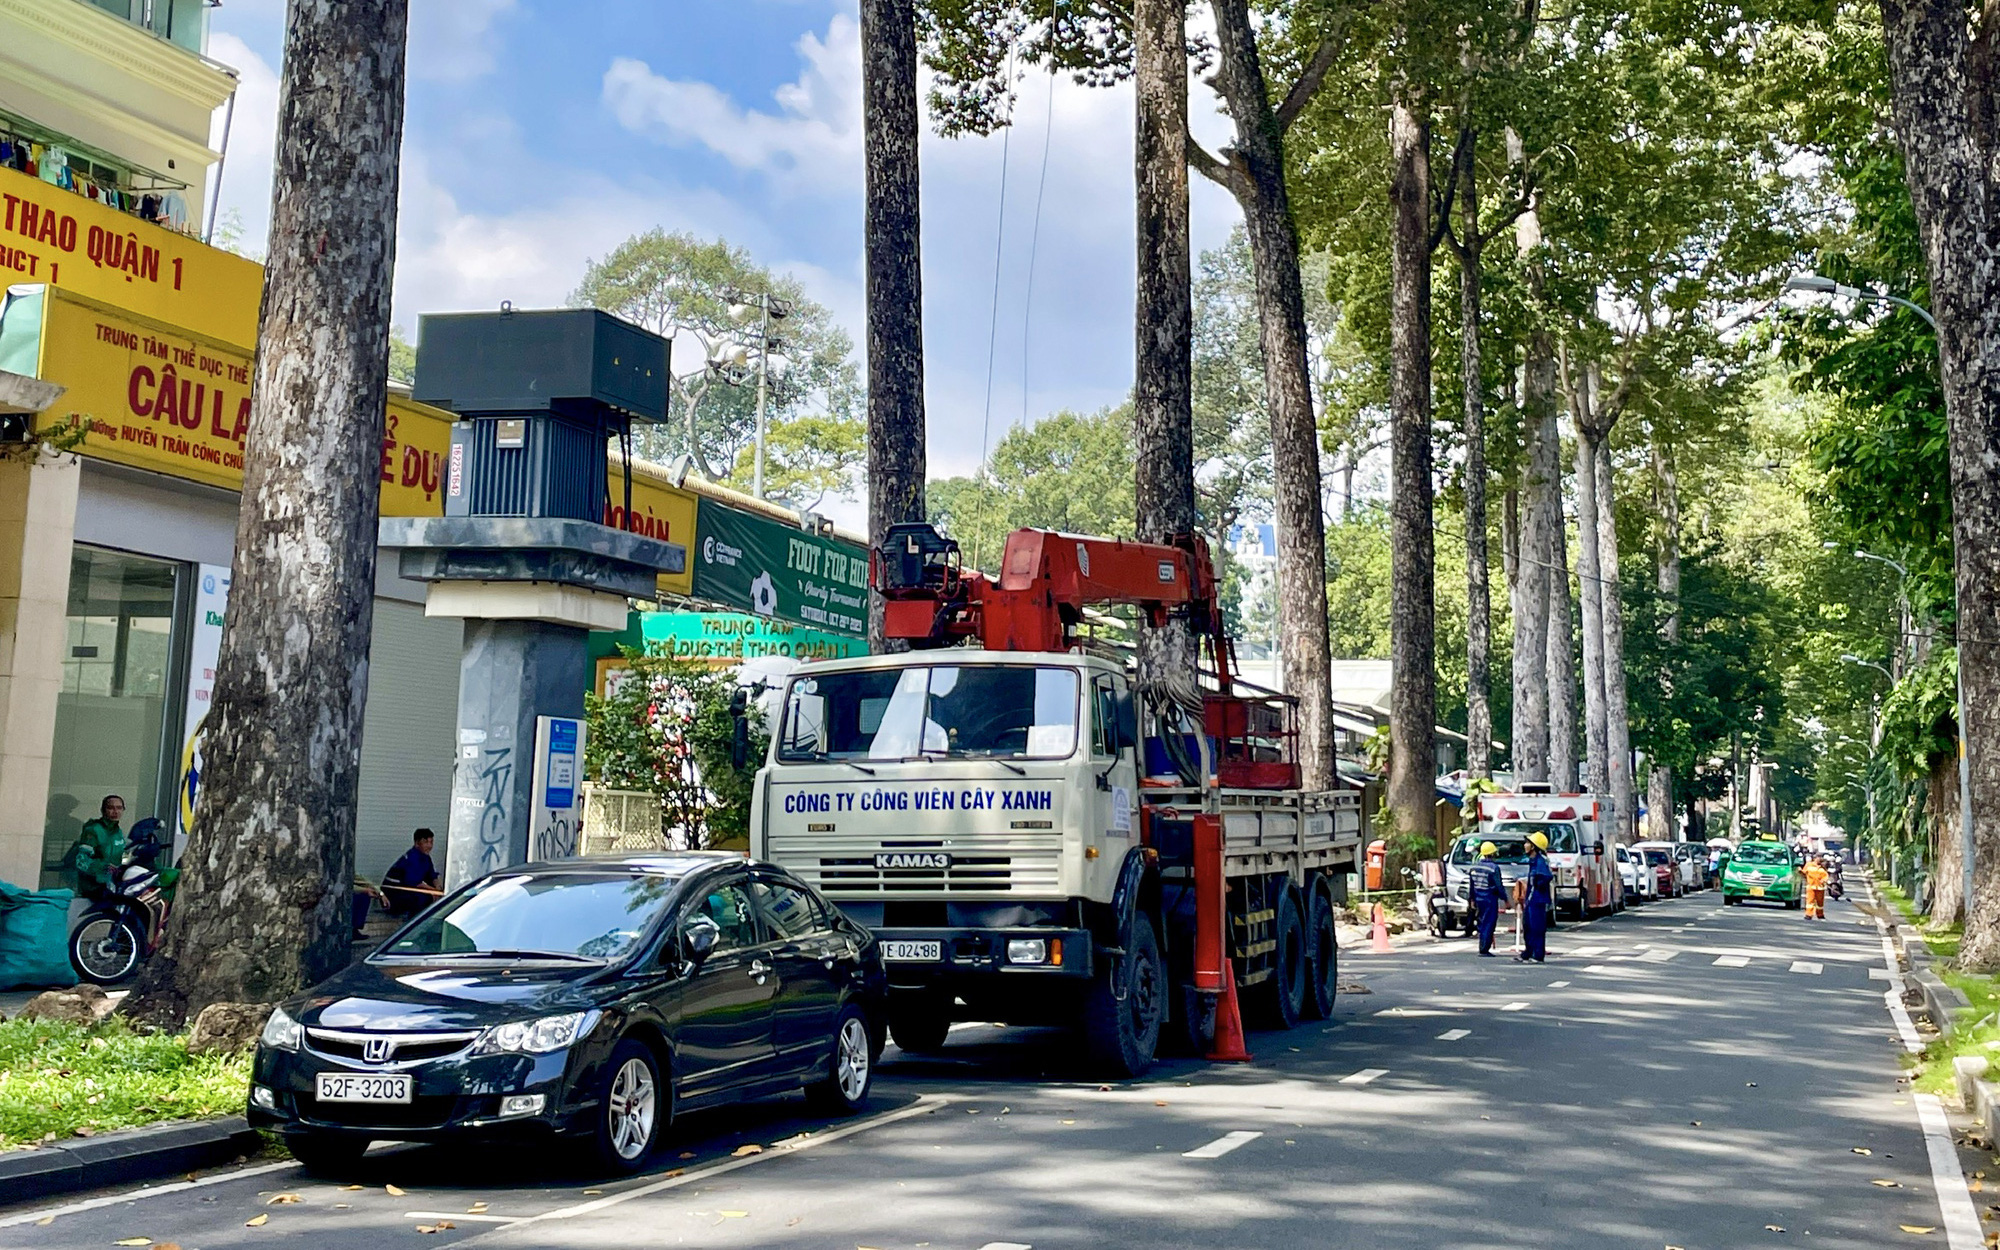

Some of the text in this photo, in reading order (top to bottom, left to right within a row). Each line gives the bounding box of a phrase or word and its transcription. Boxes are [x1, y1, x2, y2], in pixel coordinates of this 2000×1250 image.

[3, 193, 183, 291] THAO QUẬN 1
[50, 263, 59, 284] 1
[95, 323, 250, 385] TRUNG TÂM THỂ DỤC THỂ
[128, 363, 205, 431] CÂU
[192, 441, 220, 464] CÔNG
[402, 444, 448, 502] DỤ
[787, 537, 821, 575] FOOT
[823, 549, 848, 583] FOR
[701, 619, 755, 636] TRUNG
[749, 640, 792, 659] THAO
[785, 786, 1052, 813] CÔNG TY CÔNG VIÊN CÂY XANH
[322, 1078, 405, 1099] 52F-3203
